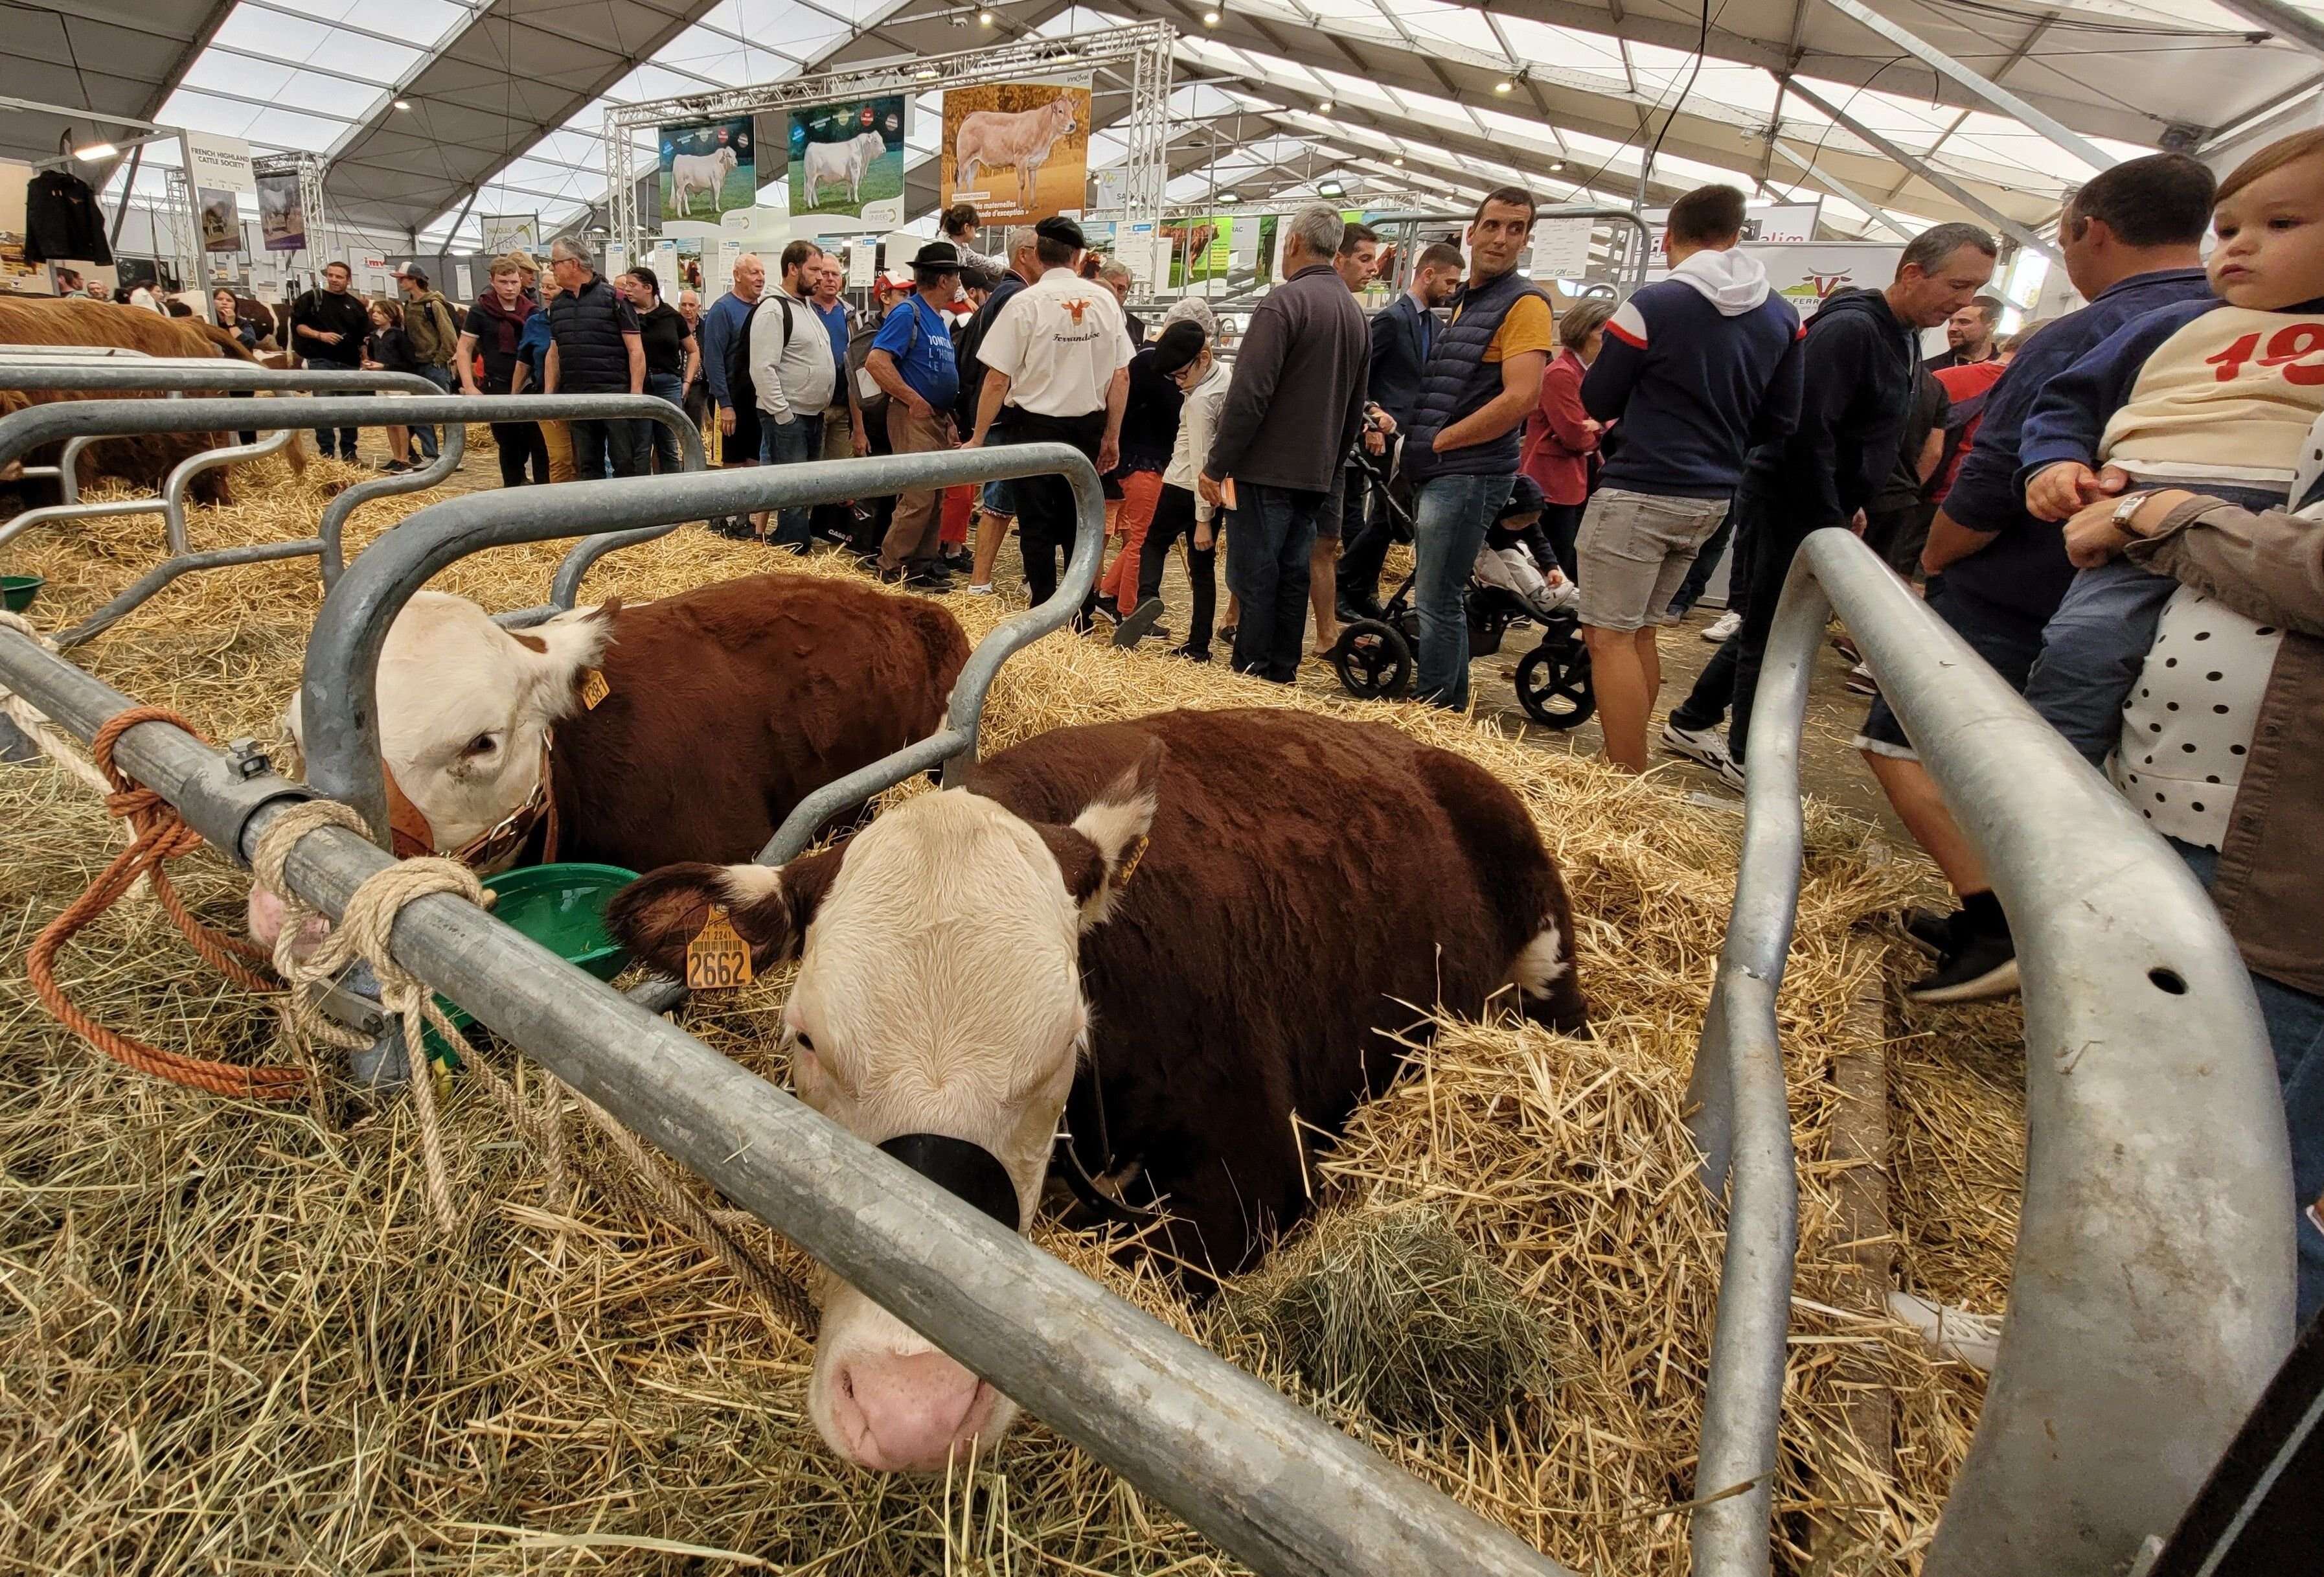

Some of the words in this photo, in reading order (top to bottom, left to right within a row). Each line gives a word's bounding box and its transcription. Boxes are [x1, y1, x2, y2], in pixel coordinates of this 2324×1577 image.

[191, 147, 216, 156] FRENCH
[218, 151, 249, 162] HIGHLAND
[198, 155, 219, 165] CATTLE
[221, 160, 245, 169] SOCIETY
[984, 200, 1016, 209] maternelles
[992, 209, 1025, 218] d'exception
[585, 677, 608, 706] 1381
[714, 930, 731, 940] 2241
[689, 951, 746, 987] 2662
